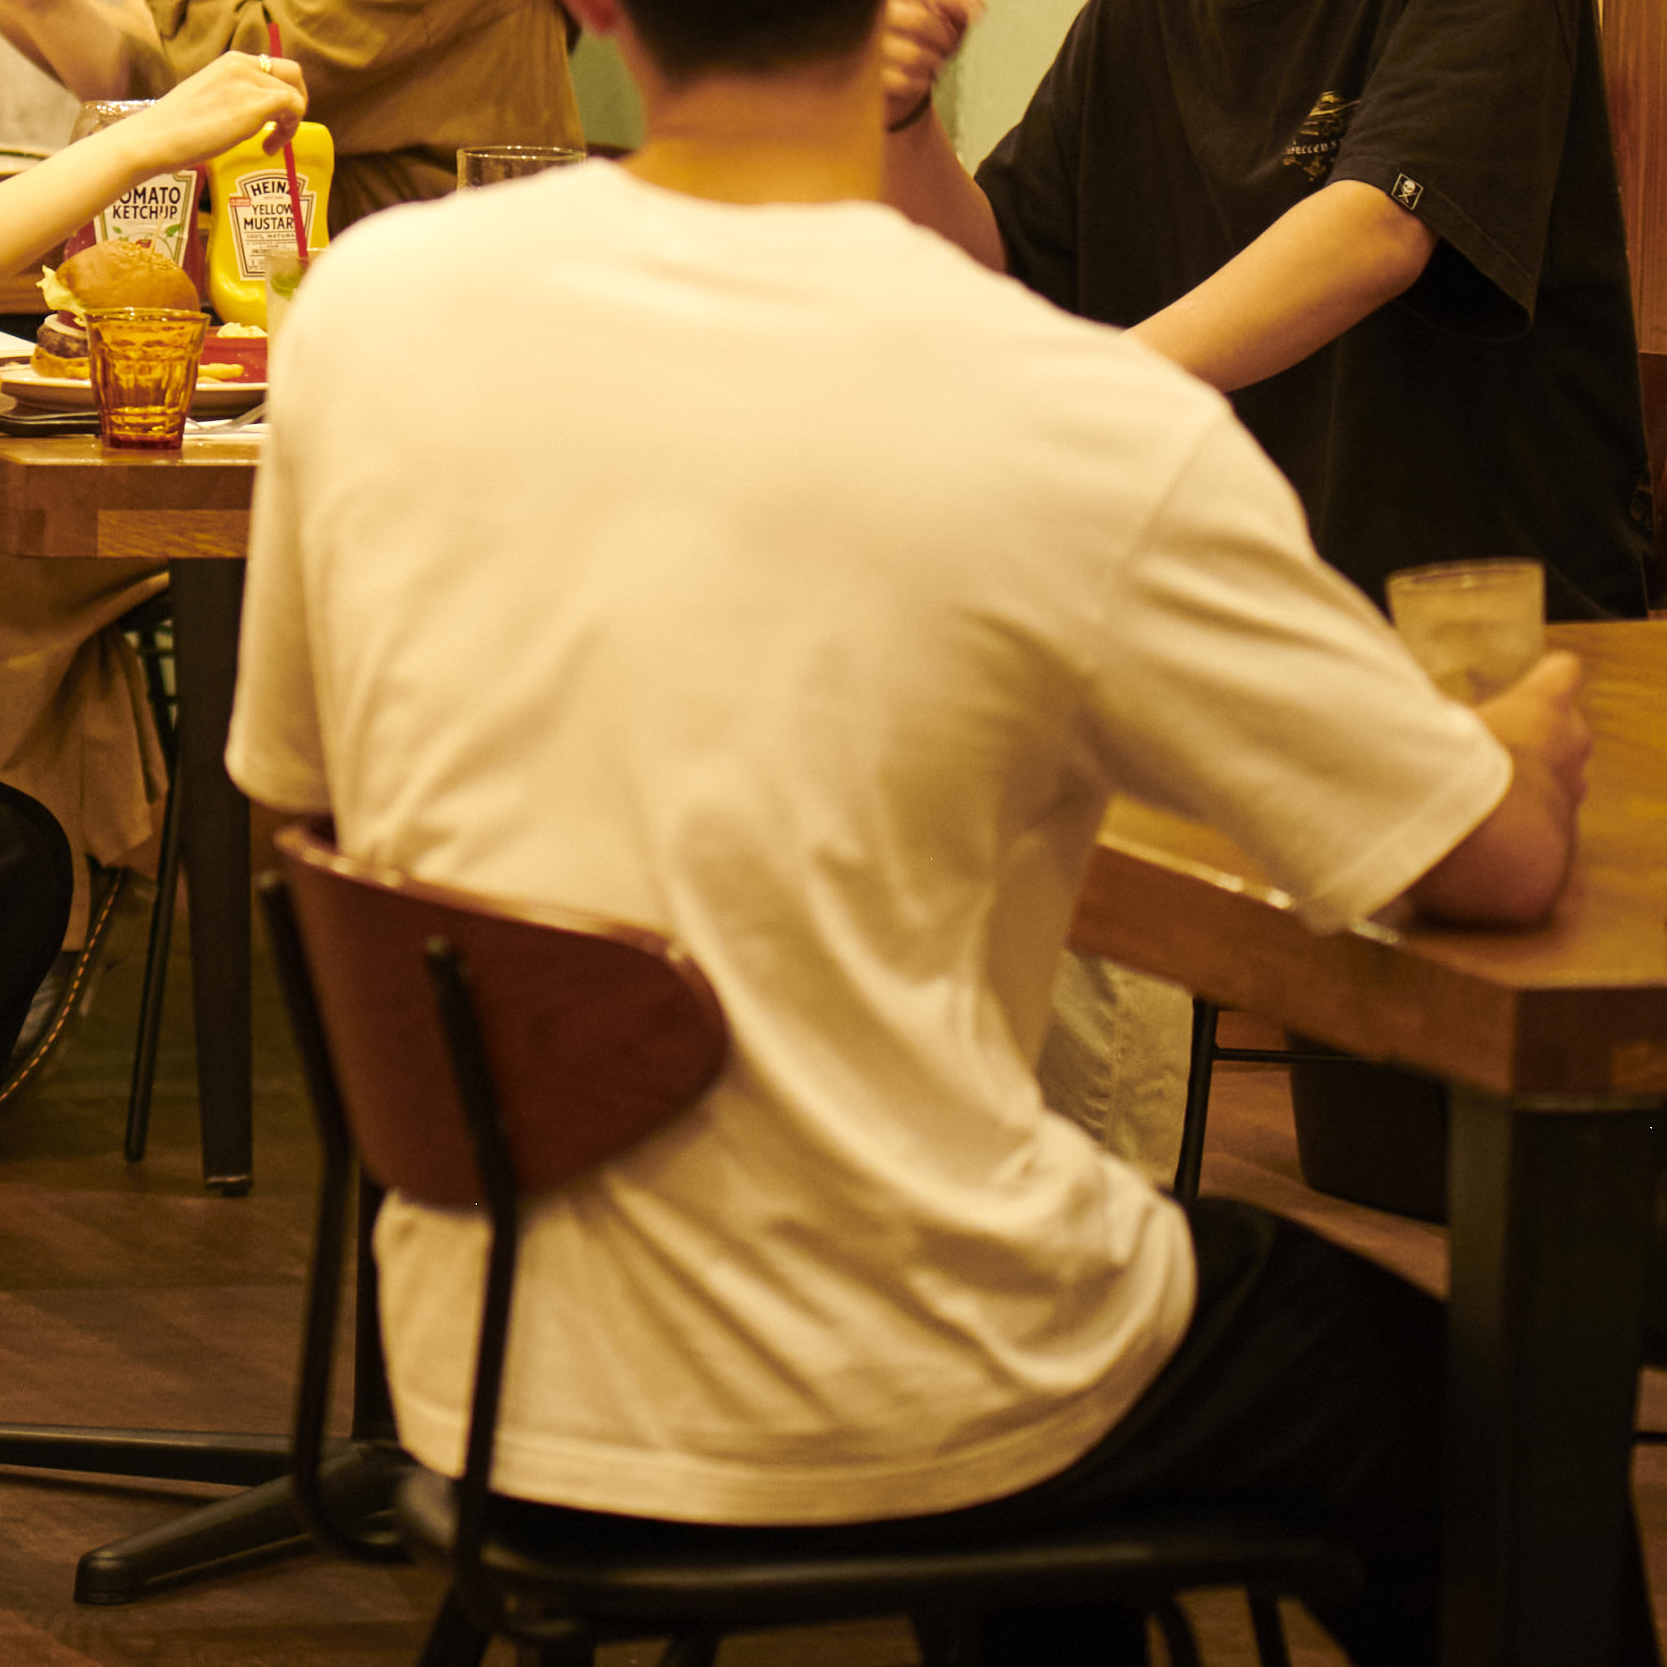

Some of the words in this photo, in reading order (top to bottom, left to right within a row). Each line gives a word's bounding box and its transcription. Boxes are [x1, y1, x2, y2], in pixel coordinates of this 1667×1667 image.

[119, 186, 181, 205] OMATO
[251, 180, 291, 197] HEIN
[113, 205, 178, 220] KETCHUP
[244, 217, 296, 231] MUSTAR
